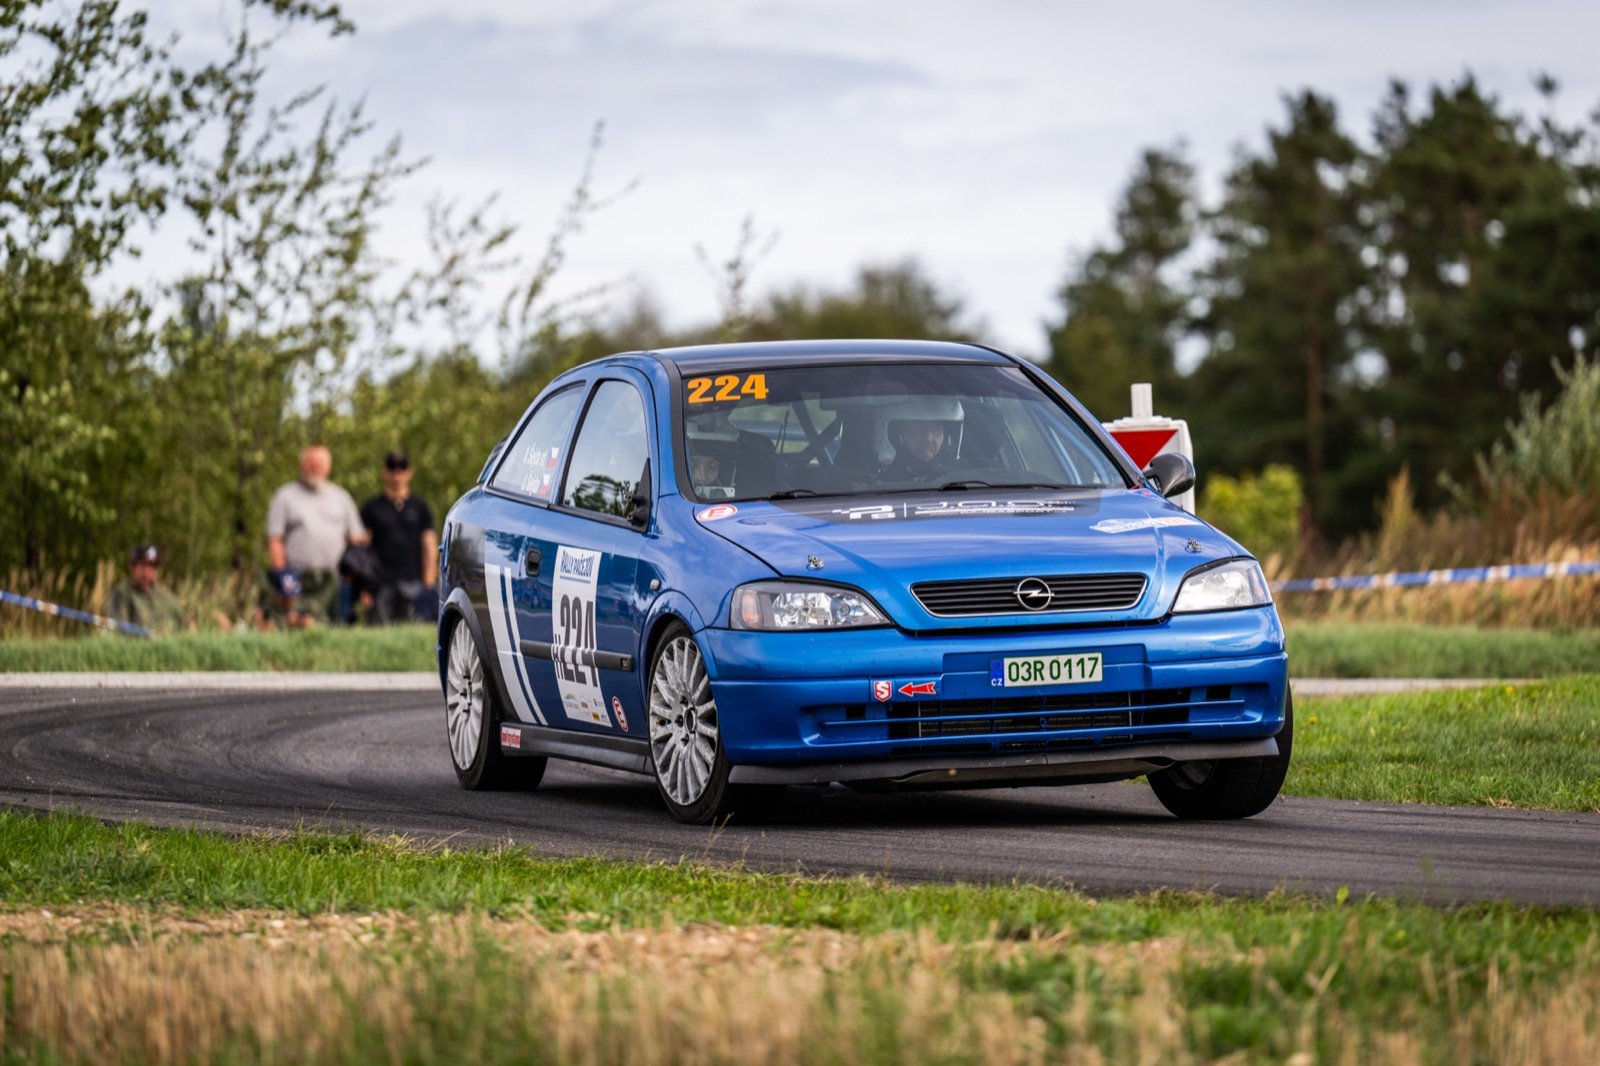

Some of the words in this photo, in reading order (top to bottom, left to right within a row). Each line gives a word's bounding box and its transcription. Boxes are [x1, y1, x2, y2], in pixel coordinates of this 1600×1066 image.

[687, 373, 769, 404] 224
[561, 549, 575, 574] RALLY
[560, 594, 599, 688] 224
[1008, 660, 1045, 682] 03R
[1049, 657, 1099, 680] 0117
[991, 678, 1003, 687] CZ
